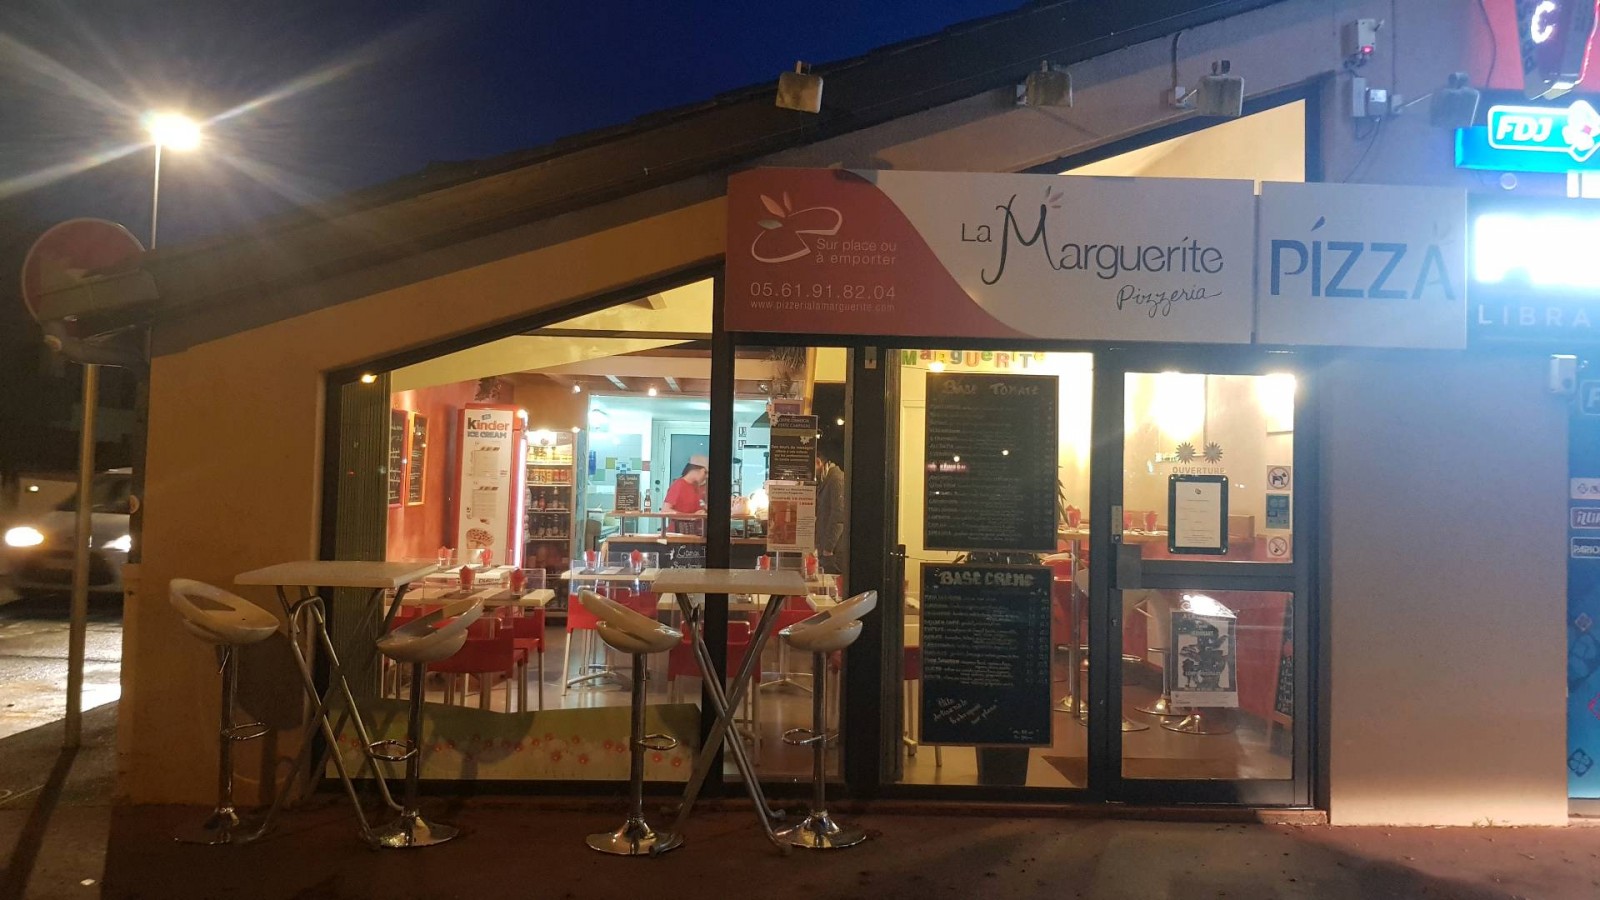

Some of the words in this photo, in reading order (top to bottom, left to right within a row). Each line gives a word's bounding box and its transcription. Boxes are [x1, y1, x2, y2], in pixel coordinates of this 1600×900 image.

[1496, 115, 1553, 142] FDJ
[816, 238, 838, 252] Sur
[842, 239, 878, 255] place
[881, 241, 897, 252] ou
[961, 223, 993, 243] La
[980, 193, 1224, 286] Marguerite
[815, 250, 824, 264] à
[830, 253, 897, 267] emporter
[750, 282, 896, 300] 05.61.91.82.04
[750, 300, 896, 313] www.pizzerialamarguerite.com
[1116, 284, 1223, 318] Pizzeria
[467, 417, 511, 431] Kinder
[480, 431, 507, 439] CREAM
[1172, 466, 1226, 475] OUVERTURE
[940, 571, 981, 586] BASE
